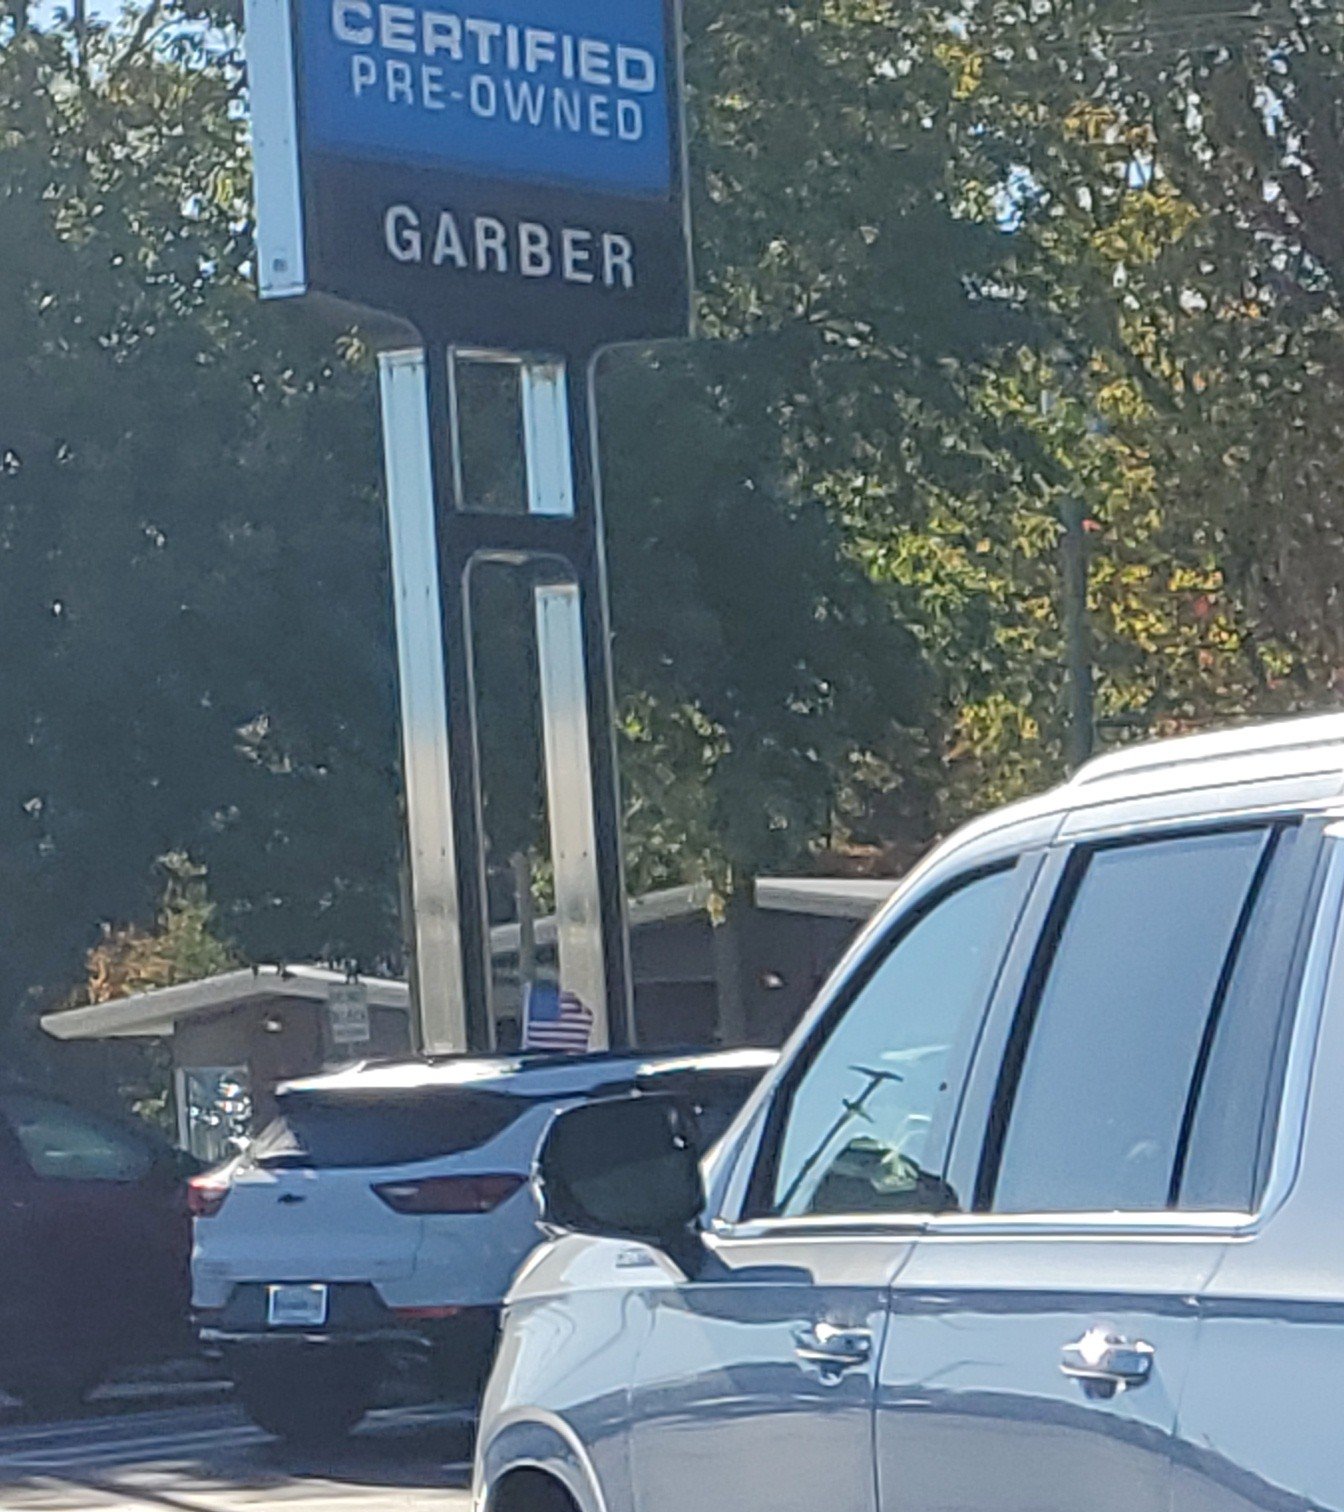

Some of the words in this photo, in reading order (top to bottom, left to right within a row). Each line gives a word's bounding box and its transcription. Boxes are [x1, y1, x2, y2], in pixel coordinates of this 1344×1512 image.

[331, 0, 656, 93] CERTIFIED
[352, 54, 643, 141] PRE-OWNED
[384, 204, 634, 289] GARBER
